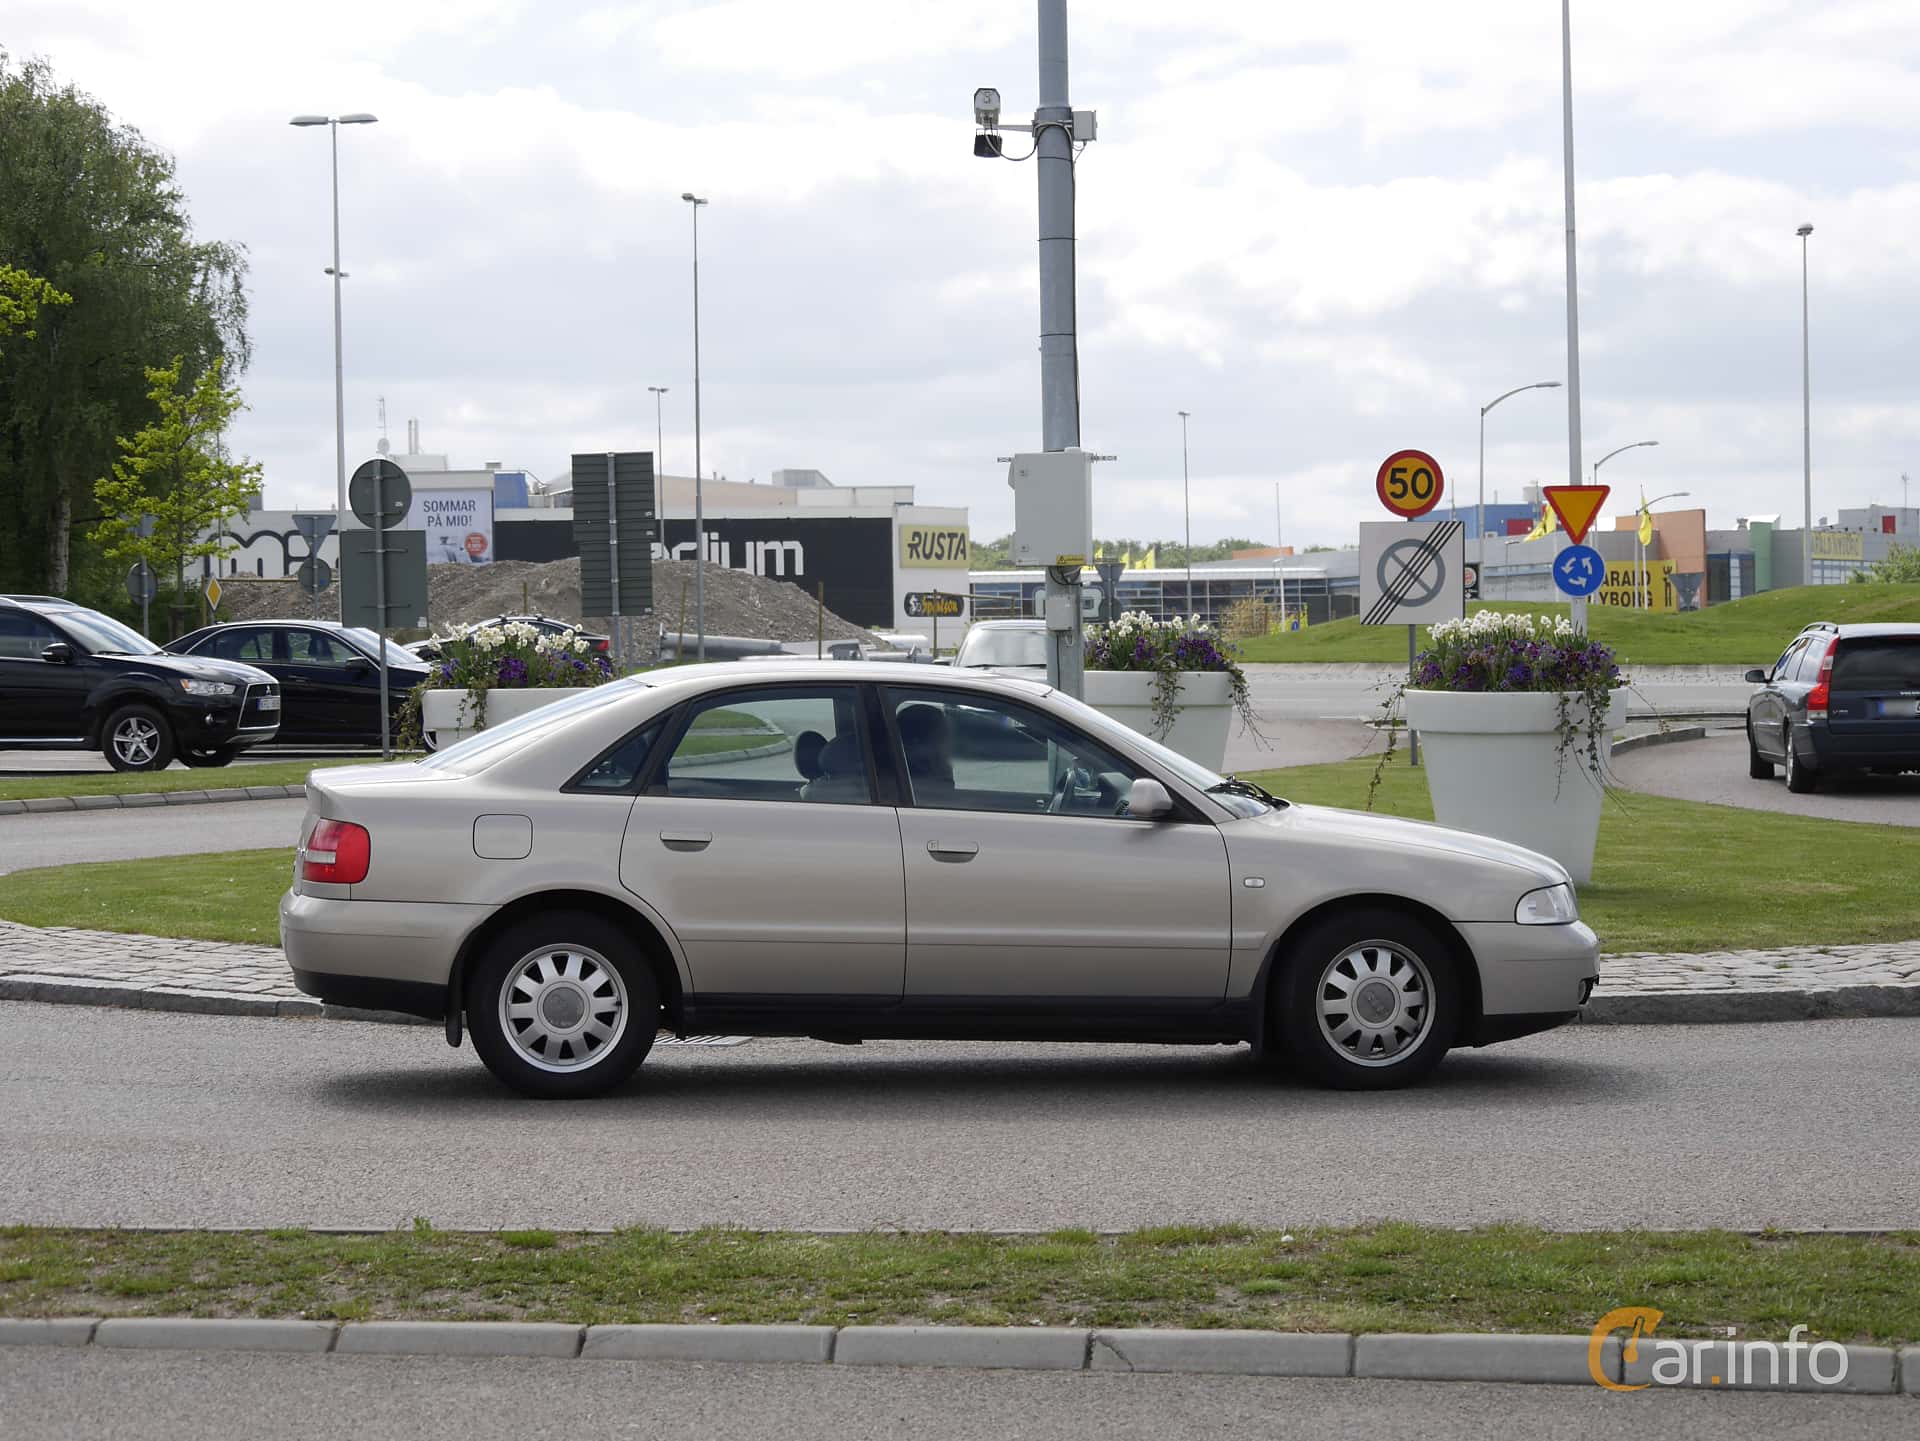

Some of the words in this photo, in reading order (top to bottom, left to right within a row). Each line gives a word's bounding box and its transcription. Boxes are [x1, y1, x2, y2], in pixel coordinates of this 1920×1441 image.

[1390, 468, 1434, 500] 50
[424, 500, 476, 512] SOMMAR
[428, 513, 442, 527] PÅ
[446, 515, 472, 527] MIO!
[907, 531, 967, 561] RUSTA
[1596, 591, 1654, 608] YBORG
